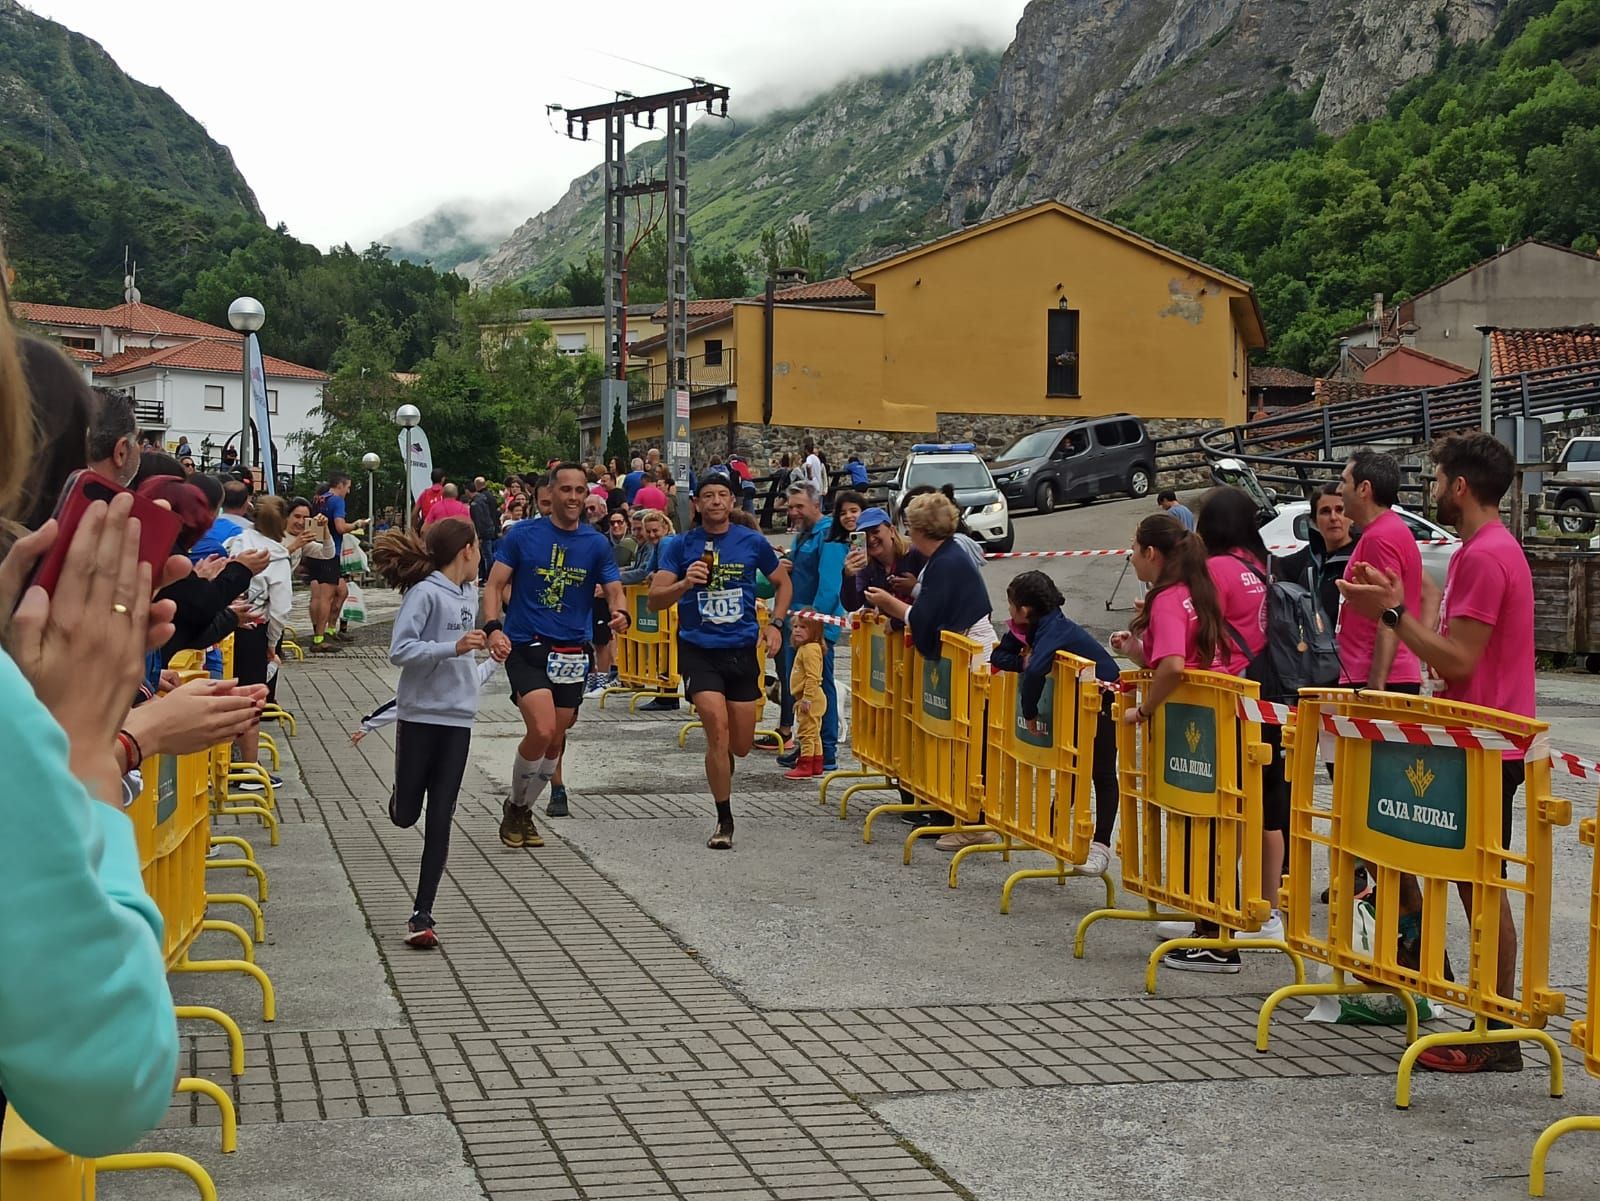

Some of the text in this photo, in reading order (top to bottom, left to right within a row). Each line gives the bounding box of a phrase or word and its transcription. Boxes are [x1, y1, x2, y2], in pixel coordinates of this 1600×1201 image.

[703, 598, 741, 617] 405
[550, 662, 585, 677] 369
[1169, 756, 1213, 778] CAJA RURAL
[1377, 798, 1458, 831] CAJA RURAL
